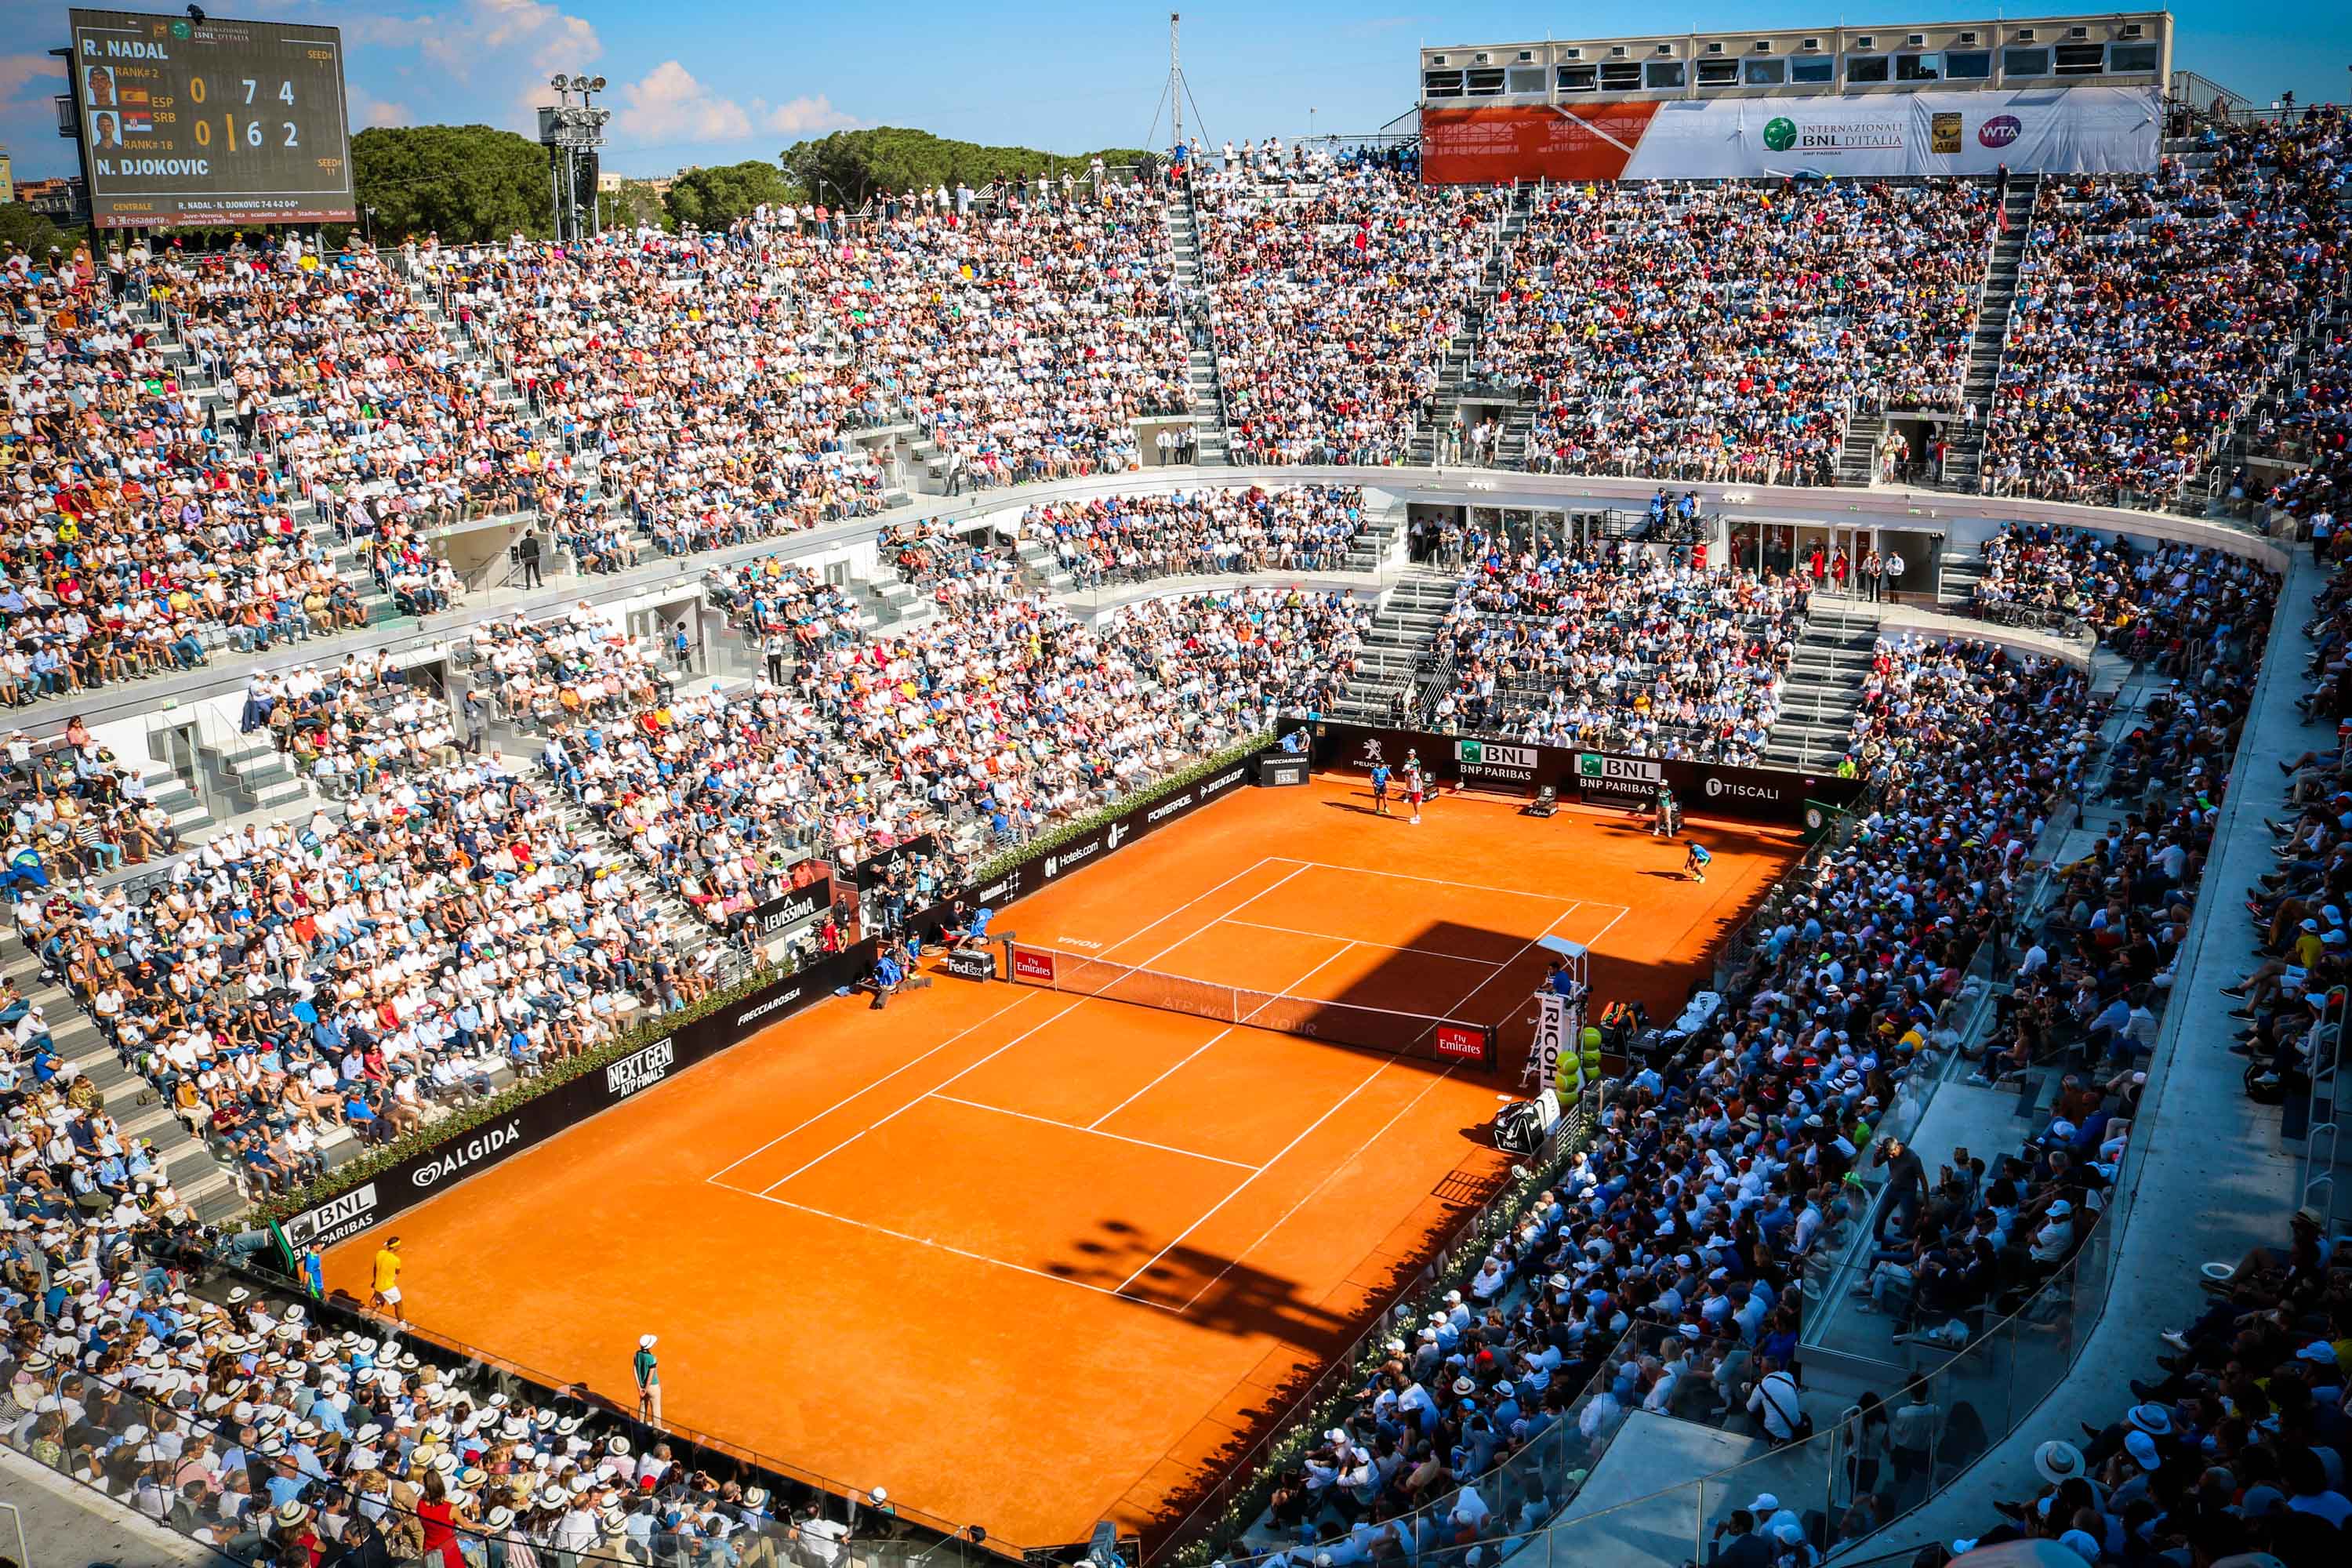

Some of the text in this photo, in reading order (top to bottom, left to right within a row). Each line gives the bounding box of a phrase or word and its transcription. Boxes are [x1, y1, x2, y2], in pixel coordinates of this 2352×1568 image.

[82, 39, 169, 60] R. NADAL
[115, 67, 159, 78] RANK# 2
[191, 77, 294, 105] 0 7 4
[151, 96, 174, 107] ESP
[153, 113, 176, 123] SRB
[195, 120, 298, 147] 0 6 2
[1802, 123, 1903, 132] INTERNAZIONALI
[1982, 126, 2017, 137] WTA
[162, 140, 173, 150] 18
[1802, 134, 1902, 147] BNL D'ITALIA
[96, 159, 209, 176] N. DJOKOVIC
[113, 202, 152, 211] CENTRALE
[178, 201, 187, 210] R.
[187, 201, 212, 210] NADAL
[1353, 760, 1392, 769] PEUGET
[1486, 747, 1531, 765] BNL
[1277, 774, 1290, 782] 153
[1460, 764, 1531, 780] BNP PARIBAS
[1607, 760, 1656, 779] BNL
[1207, 768, 1244, 793] DUNLOP
[1580, 778, 1654, 795] BNP PARIBAS
[1725, 784, 1779, 800] TISCALI
[1148, 793, 1192, 823] POWERADE
[1059, 839, 1099, 868] Hotels.com
[764, 896, 816, 933] LEVISSIMA
[948, 959, 982, 977] FedEx
[1017, 962, 1051, 976] Emirates
[1028, 957, 1038, 966] Fly
[737, 987, 800, 1026] FRECCIAROSSA
[1439, 1039, 1481, 1054] Emirates
[1454, 1034, 1467, 1044] Fly
[1544, 1007, 1559, 1081] RICOH
[609, 1041, 671, 1088] NEXT GEN
[620, 1065, 666, 1098] ATP FINALS
[442, 1121, 521, 1176] ALGIDA
[318, 1192, 370, 1229] BNL
[292, 1213, 373, 1261] BN PARIBAS
